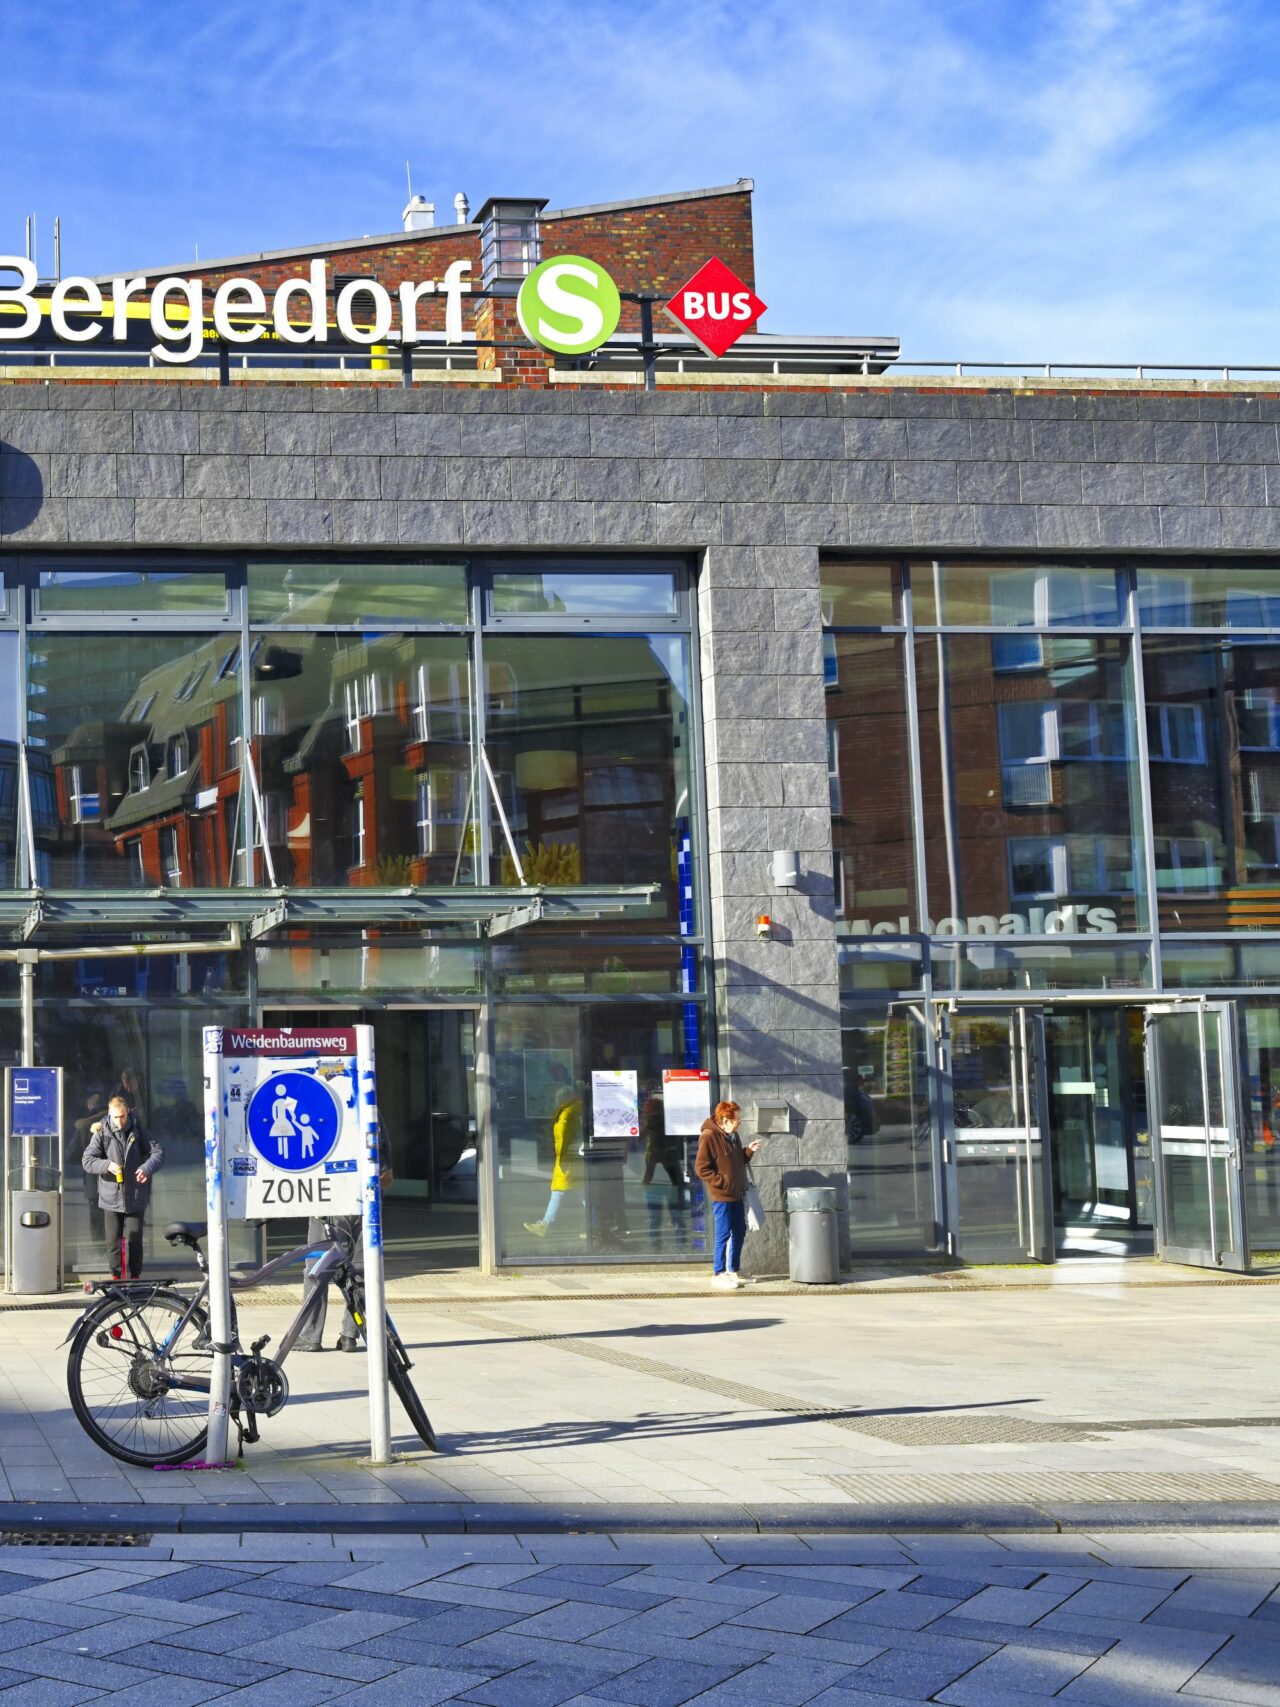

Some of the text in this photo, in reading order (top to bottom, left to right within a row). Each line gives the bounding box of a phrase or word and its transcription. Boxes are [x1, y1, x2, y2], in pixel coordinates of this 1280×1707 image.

[535, 266, 605, 345] S
[683, 291, 752, 321] BUS
[231, 1034, 347, 1051] Weidenbaumsweg
[230, 1088, 241, 1098] 44
[262, 1177, 331, 1203] ZONE
